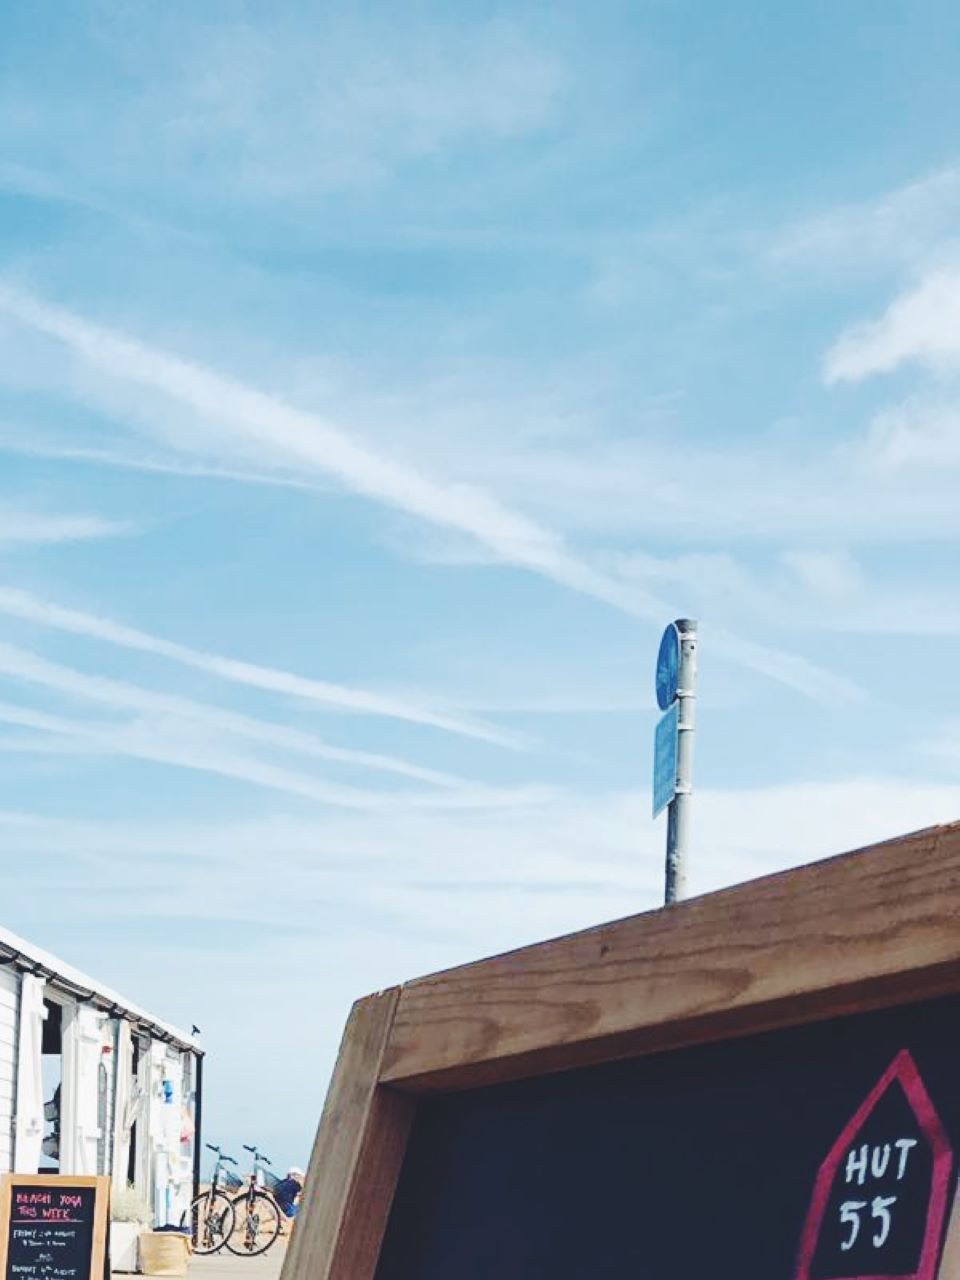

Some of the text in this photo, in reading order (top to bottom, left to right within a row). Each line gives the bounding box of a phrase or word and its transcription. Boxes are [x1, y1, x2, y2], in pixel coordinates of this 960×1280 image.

[846, 1138, 917, 1185] HUT
[60, 1194, 82, 1208] YOGA
[840, 1196, 897, 1250] 55
